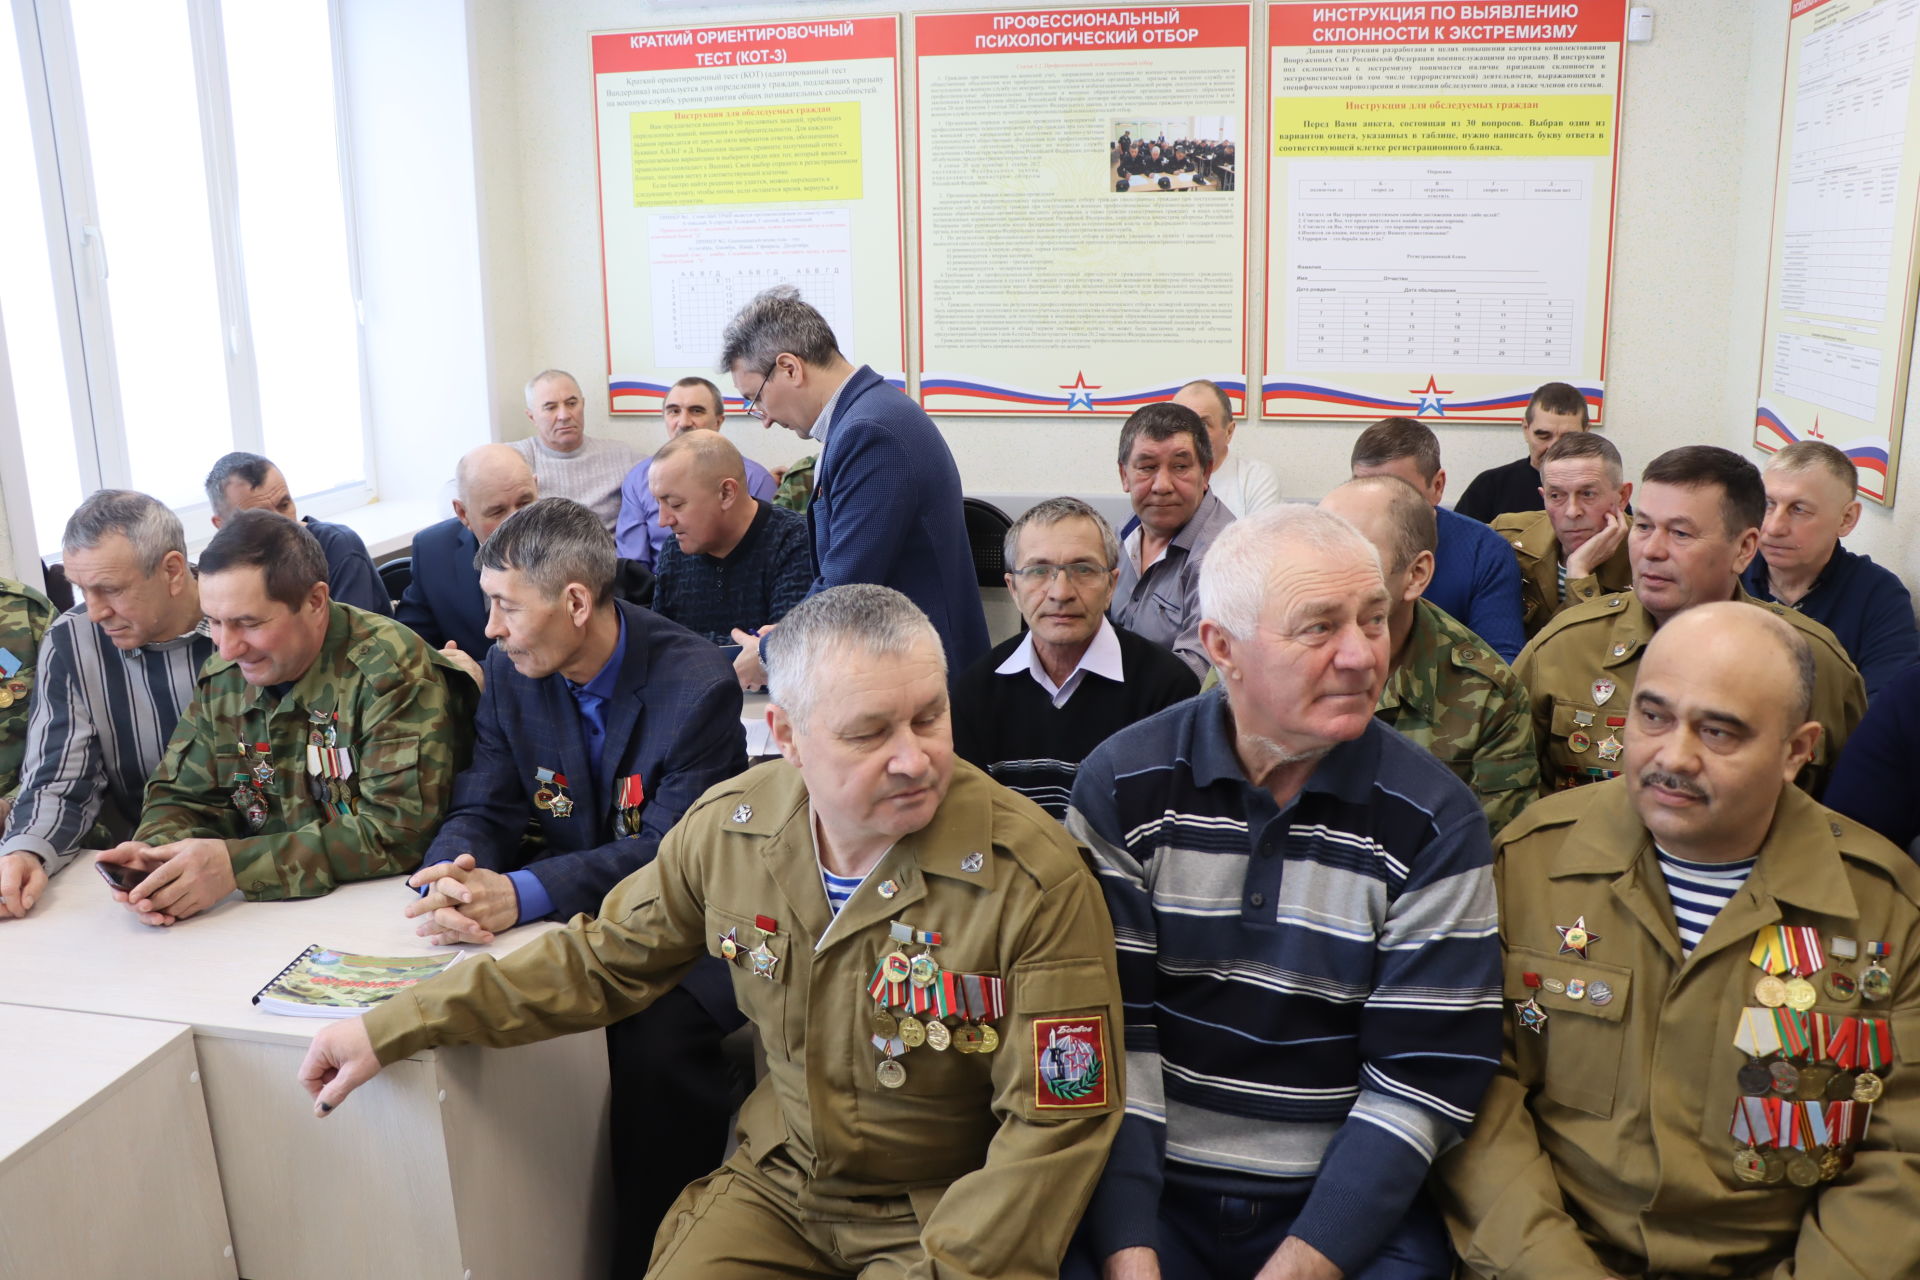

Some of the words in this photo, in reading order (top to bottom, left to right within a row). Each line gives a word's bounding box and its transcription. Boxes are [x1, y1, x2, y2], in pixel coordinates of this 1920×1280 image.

[993, 8, 1180, 30] ПРОФЕССИОНАЛЬНЫЙ
[1312, 6, 1424, 24] ИНСТРУКЦИЯ
[1430, 5, 1456, 20] ПО
[1461, 4, 1578, 20] ВЫЯВЛЕНИЮ
[630, 31, 693, 49] КРАТКИЙ
[696, 21, 854, 45] ОРИЕНТИРОВОЧНЫЙ
[975, 28, 1138, 49] ПСИХОЛОГИЧЕСКИЙ
[1142, 28, 1199, 43] ОТБОР
[1312, 26, 1430, 42] СКЛОННОСТИ
[1434, 25, 1445, 40] К
[1449, 24, 1578, 40] ЭКСТРЕМИЗМУ
[696, 51, 731, 66] ТЕСТ
[736, 48, 787, 66] (КОТ-3)
[1382, 46, 1426, 54] разработана
[1283, 56, 1332, 64] Вооруженных
[1394, 55, 1435, 63] Федерации
[1345, 101, 1406, 112] Инструкция
[1428, 101, 1493, 111] обследуемых
[1496, 103, 1538, 111] граждан
[673, 110, 724, 121] Инструкция
[741, 107, 794, 118] обследуемых
[795, 107, 831, 116] граждан
[1303, 120, 1329, 129] Перед
[1529, 119, 1563, 129] Выбрав
[1421, 132, 1457, 141] таблице,
[1536, 132, 1561, 140] букву
[1278, 144, 1354, 153] соответствующей
